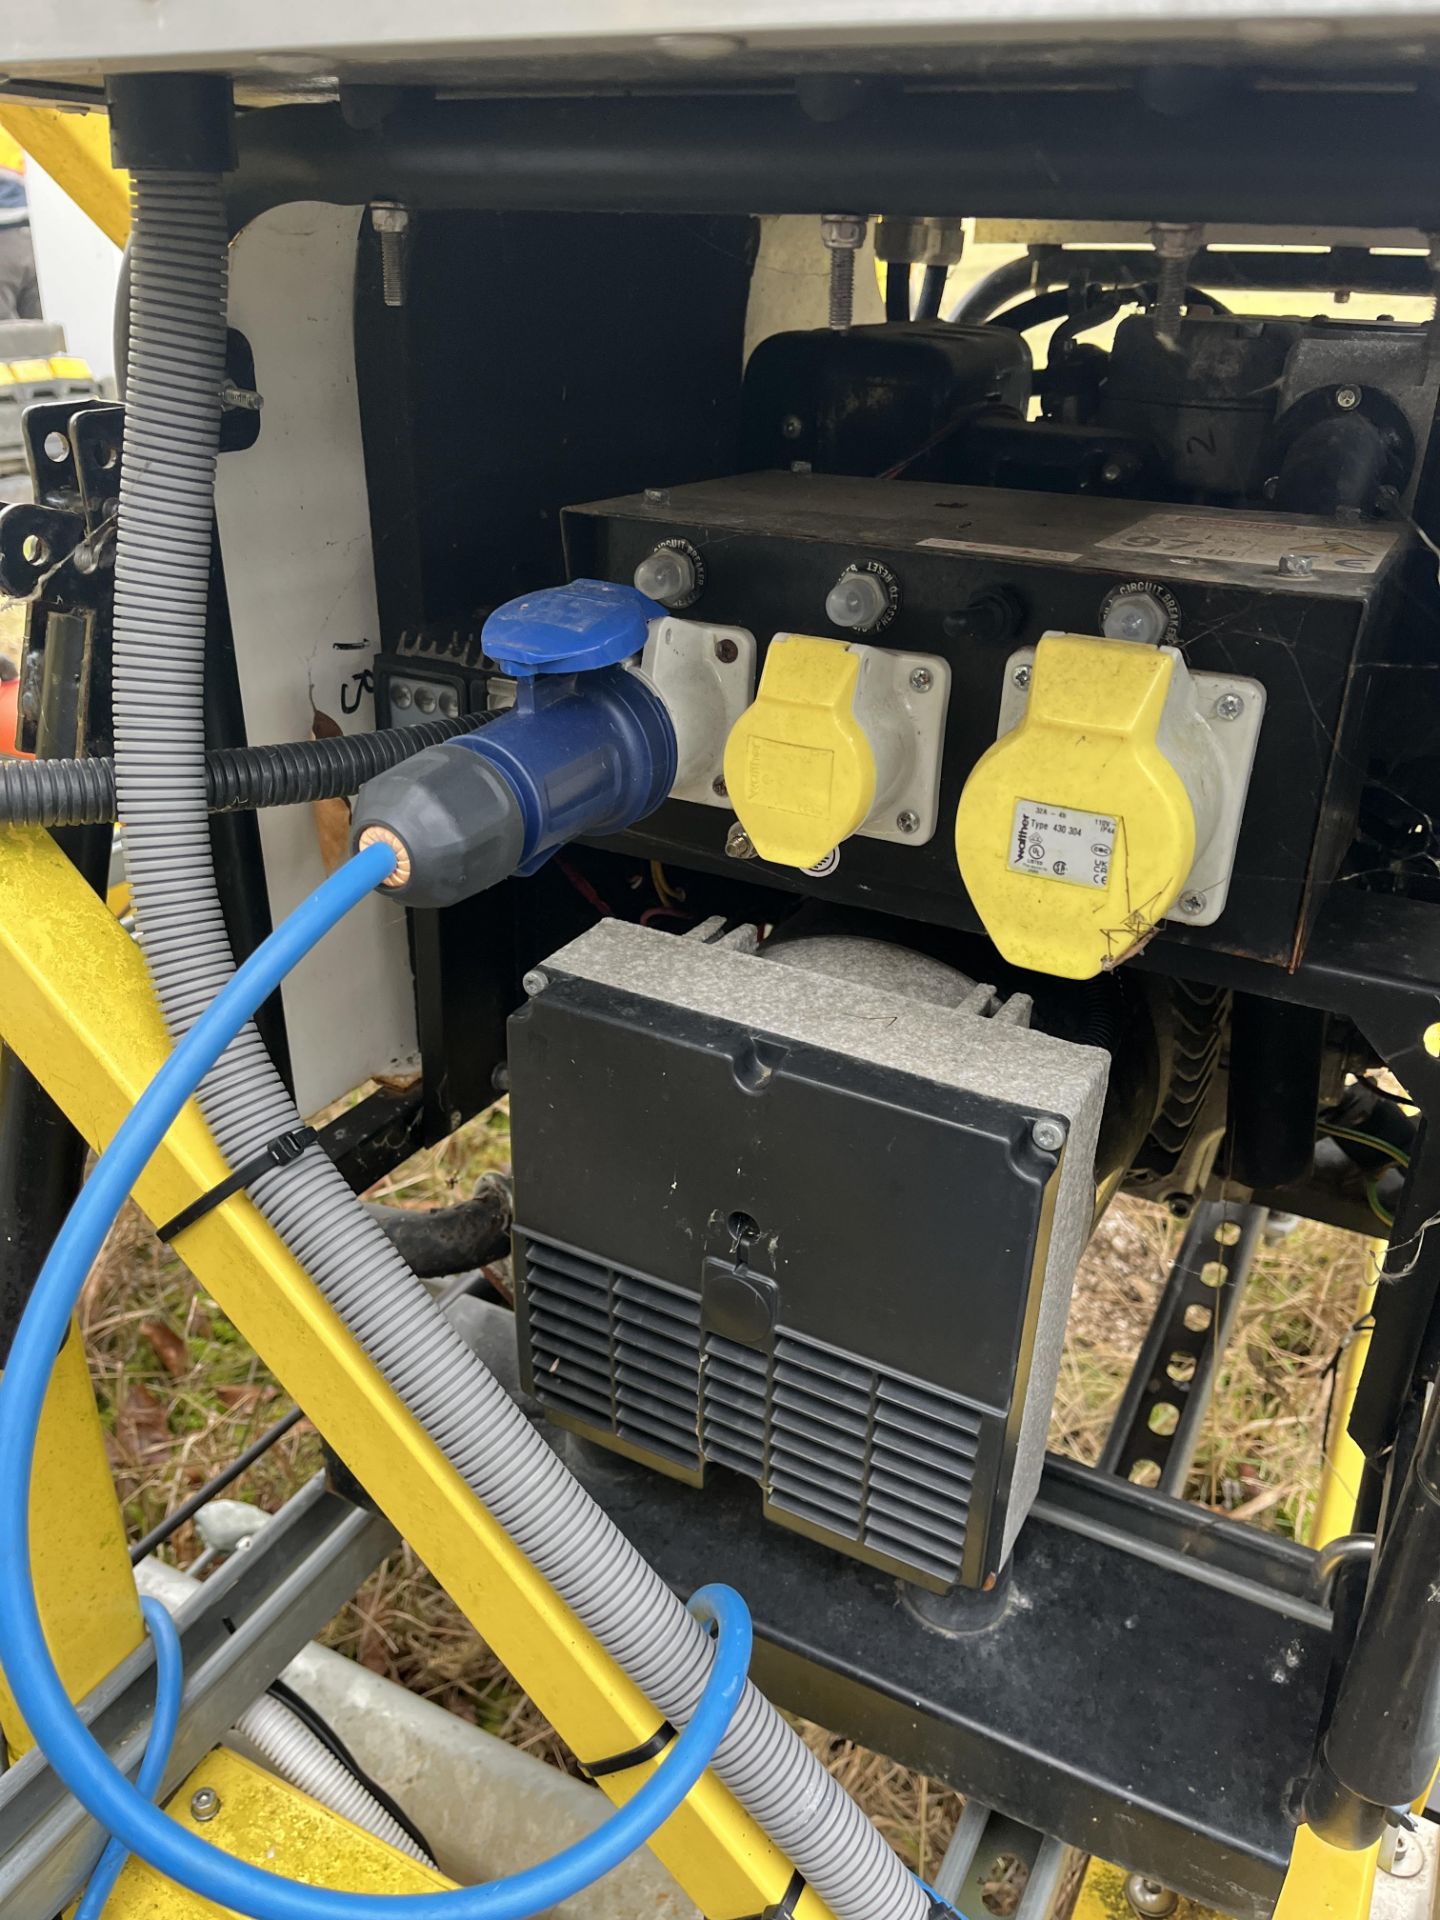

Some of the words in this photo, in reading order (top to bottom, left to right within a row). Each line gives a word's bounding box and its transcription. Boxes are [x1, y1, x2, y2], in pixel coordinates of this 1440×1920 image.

[866, 561, 894, 583] RESET
[1119, 581, 1164, 596] CIRCUIT
[1031, 819, 1049, 831] Type
[1053, 824, 1067, 834] 430
[1068, 827, 1082, 837] 304
[1014, 813, 1030, 864] walther
